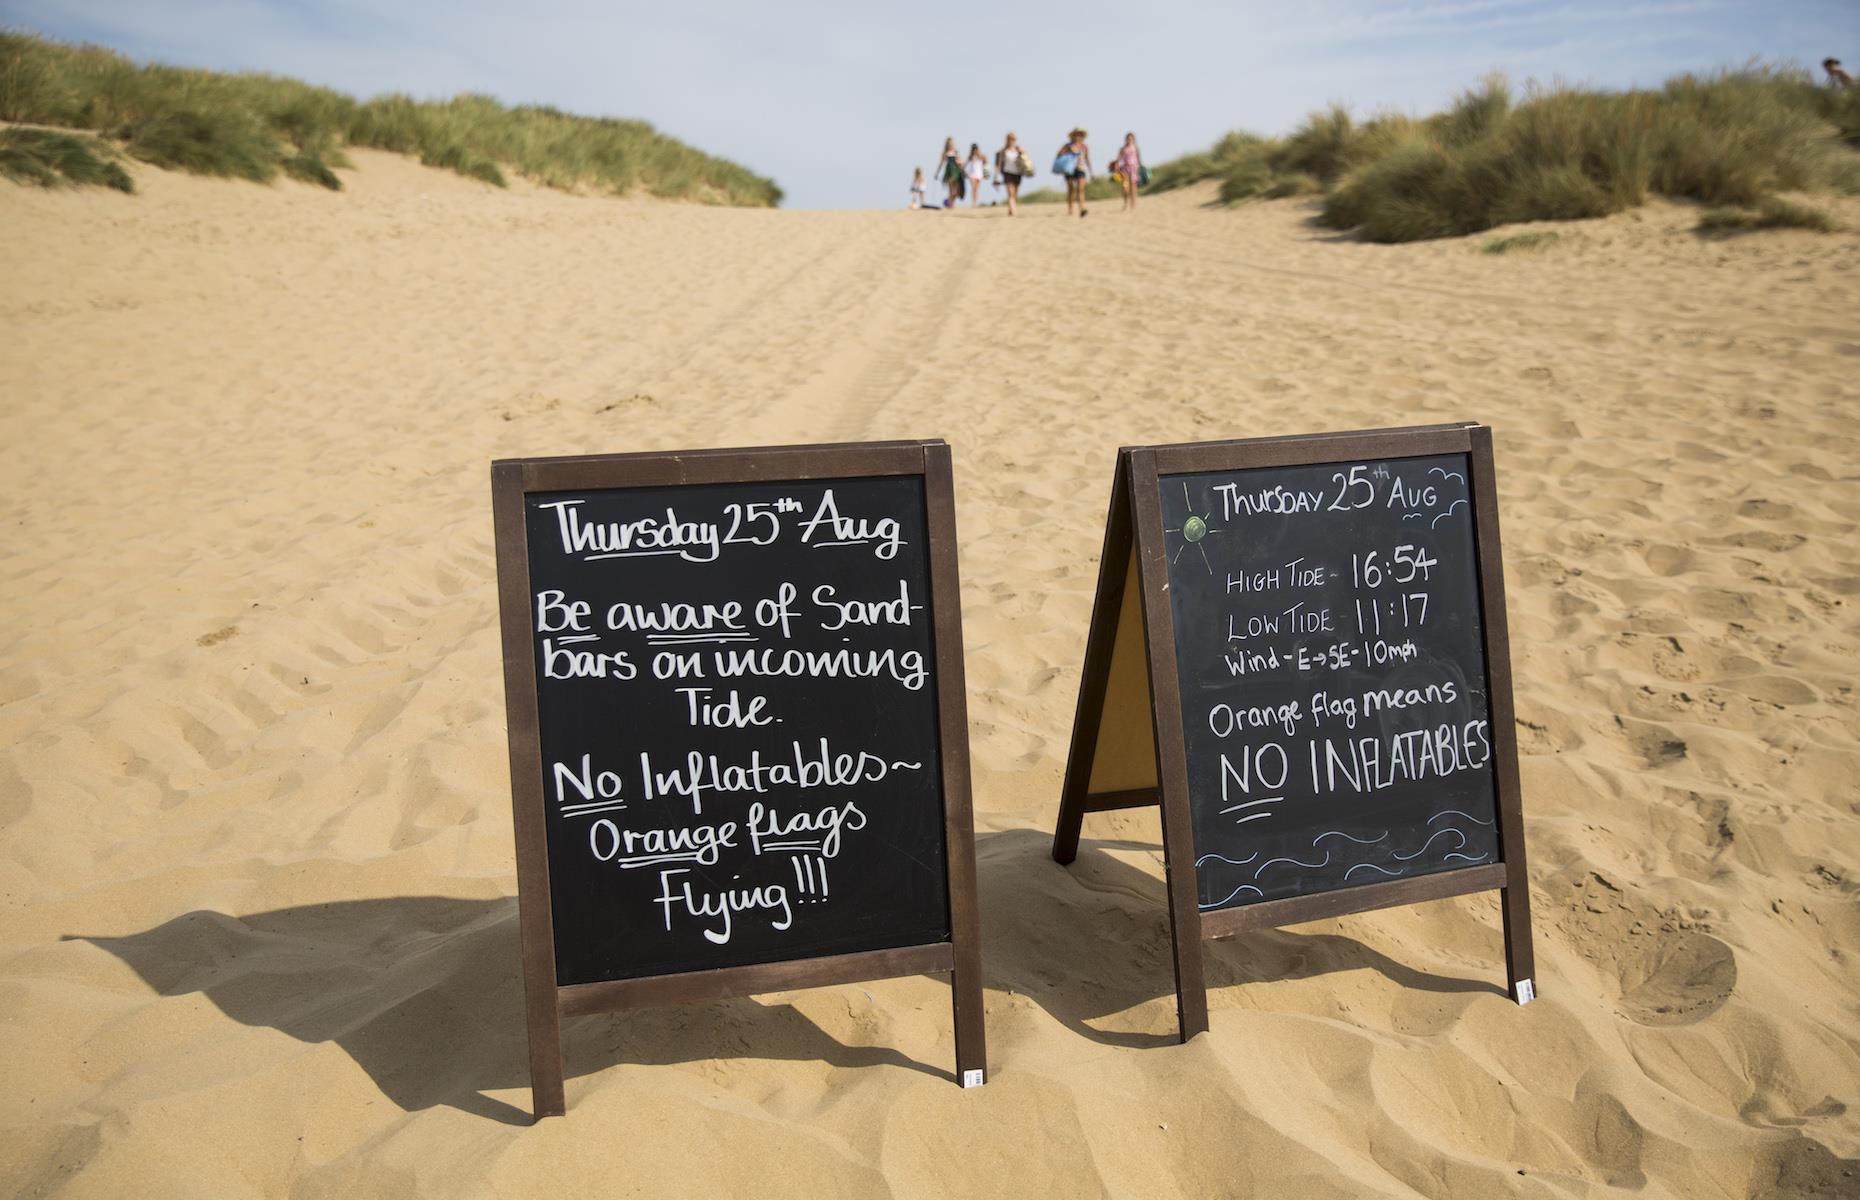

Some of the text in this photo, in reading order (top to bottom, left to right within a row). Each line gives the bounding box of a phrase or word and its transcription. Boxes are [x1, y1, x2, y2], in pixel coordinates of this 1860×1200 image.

[1328, 466, 1390, 511] 25th
[1387, 476, 1438, 508] AUG
[539, 489, 908, 562] Thursday 25th Aug
[1226, 569, 1280, 594] HIGH
[1352, 544, 1438, 588] 16:54
[537, 580, 924, 638] Be aware of Sand-
[1226, 614, 1280, 642] LOW
[1355, 592, 1429, 635] 11:17
[543, 638, 930, 690] bars on incoming
[1209, 681, 1457, 737] Orange flag means
[554, 753, 624, 801] No
[1220, 719, 1490, 801] NO INFLATABLES
[590, 801, 867, 865] Orange flags
